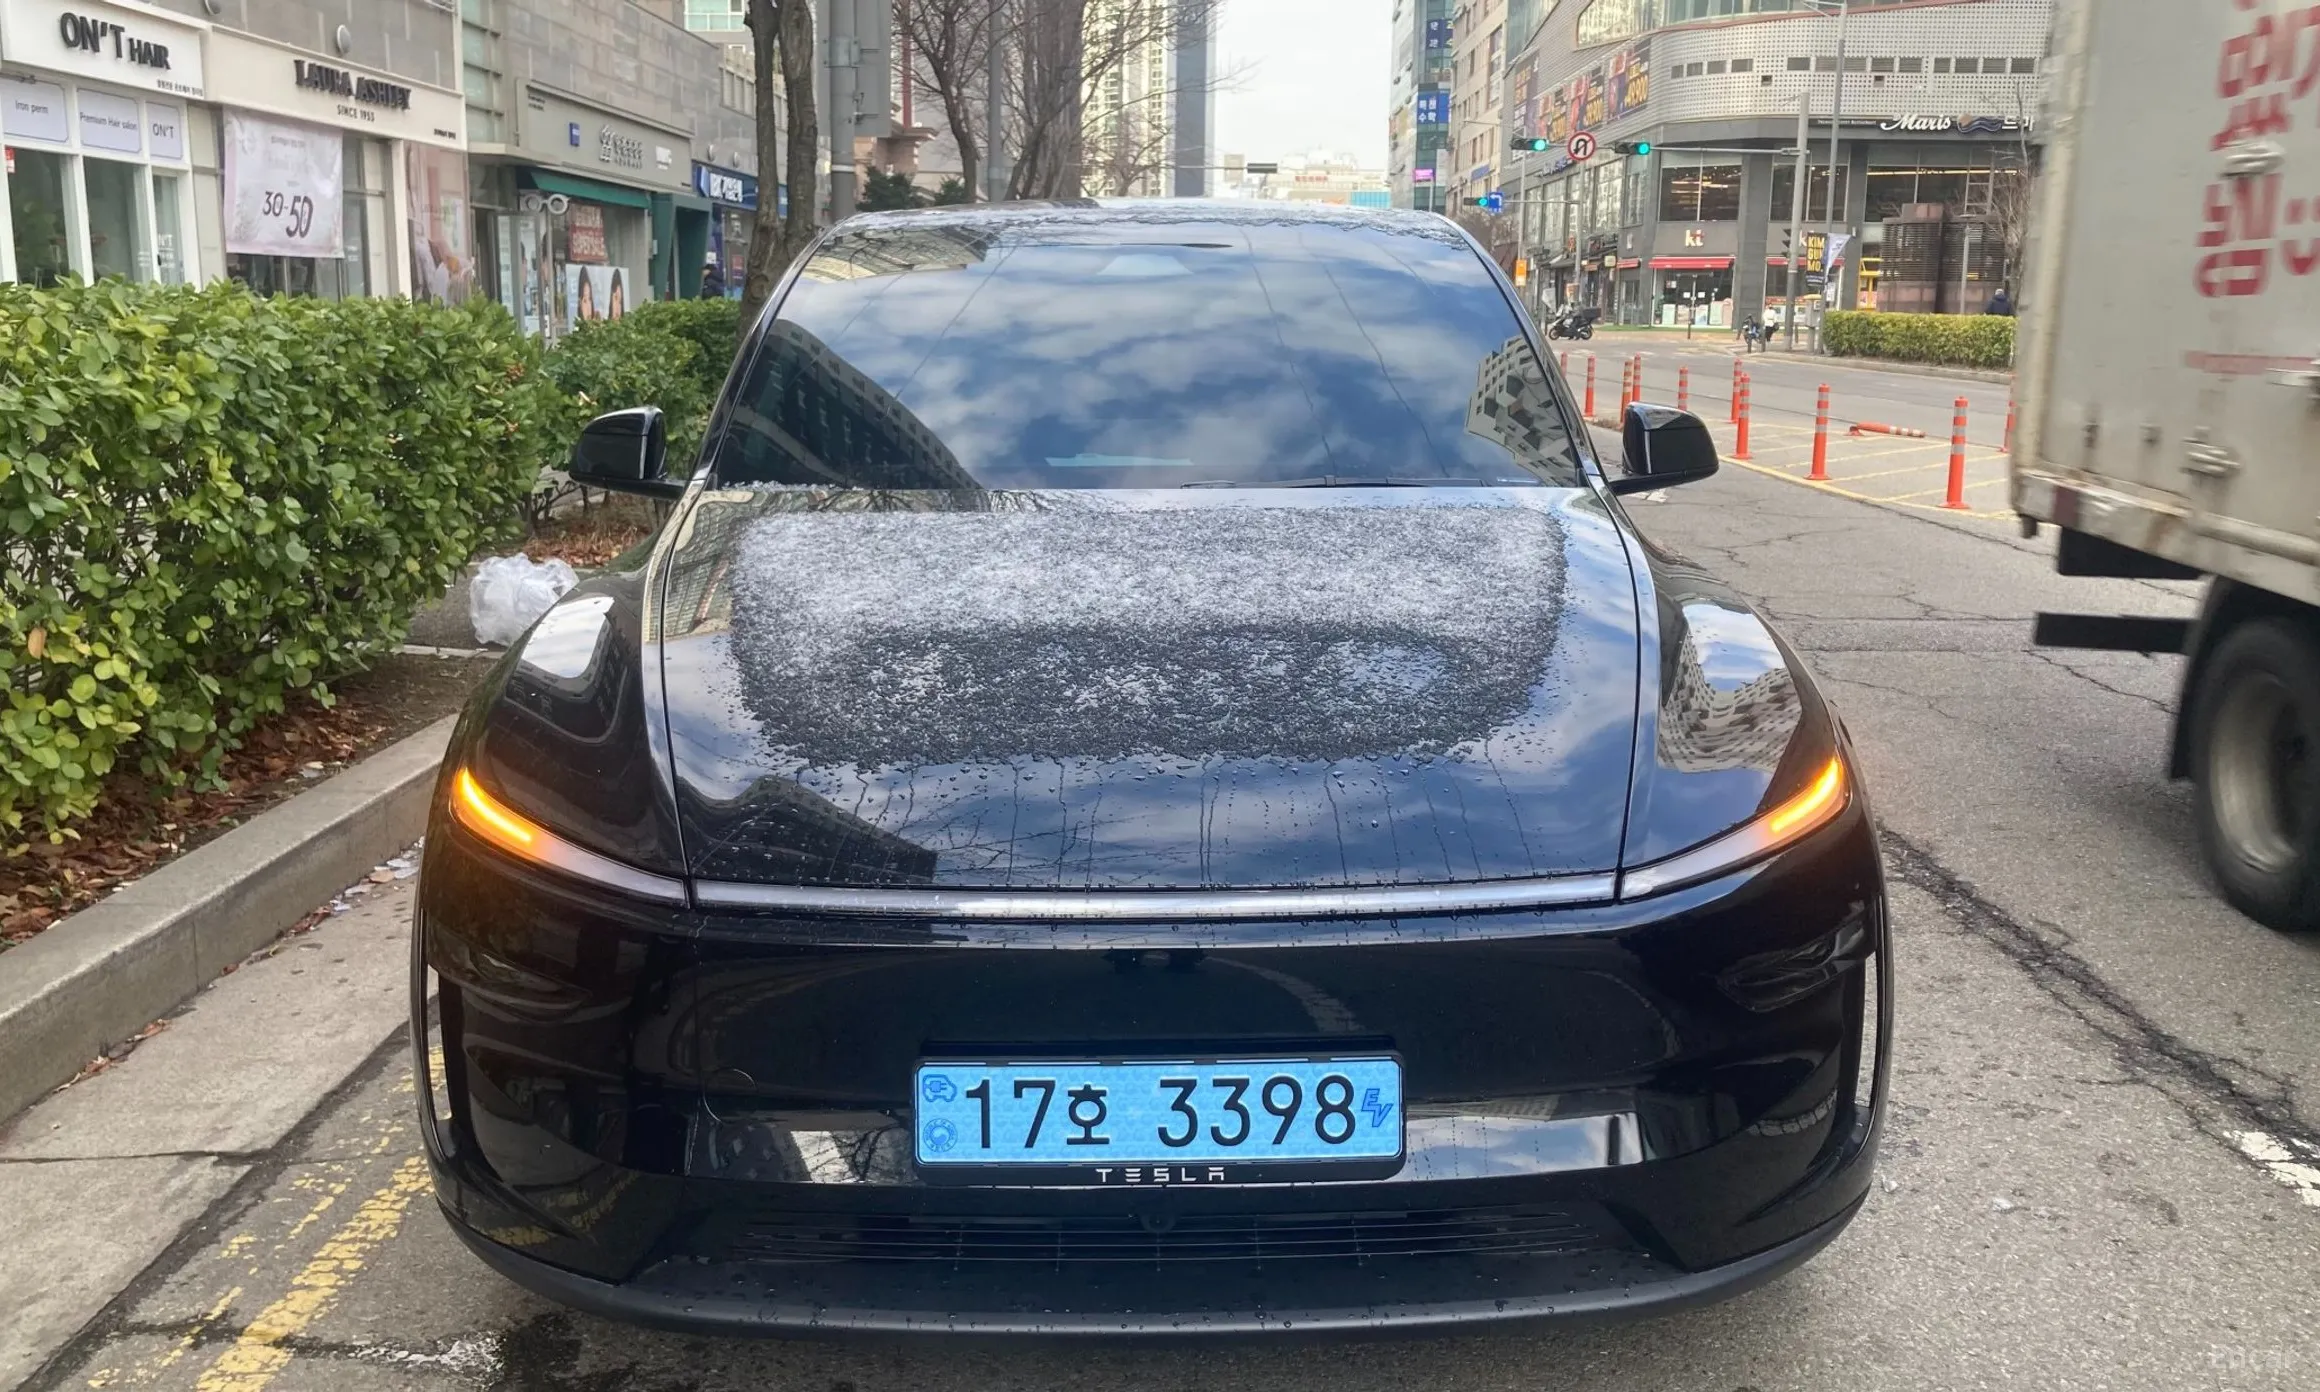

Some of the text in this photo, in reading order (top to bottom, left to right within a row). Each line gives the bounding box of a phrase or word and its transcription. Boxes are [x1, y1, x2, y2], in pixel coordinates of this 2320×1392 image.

[60, 12, 171, 70] ON'T HAIR
[294, 60, 411, 110] LAURA ASHLEY
[337, 104, 357, 119] SINCE
[152, 123, 174, 138] ON'T
[1880, 113, 1951, 131] Maris
[1685, 229, 1705, 247] kt
[965, 1078, 1111, 1149] 17호
[1157, 1075, 1356, 1147] 3398
[1361, 1087, 1394, 1128] EV
[1095, 1166, 1225, 1183] TESLA
